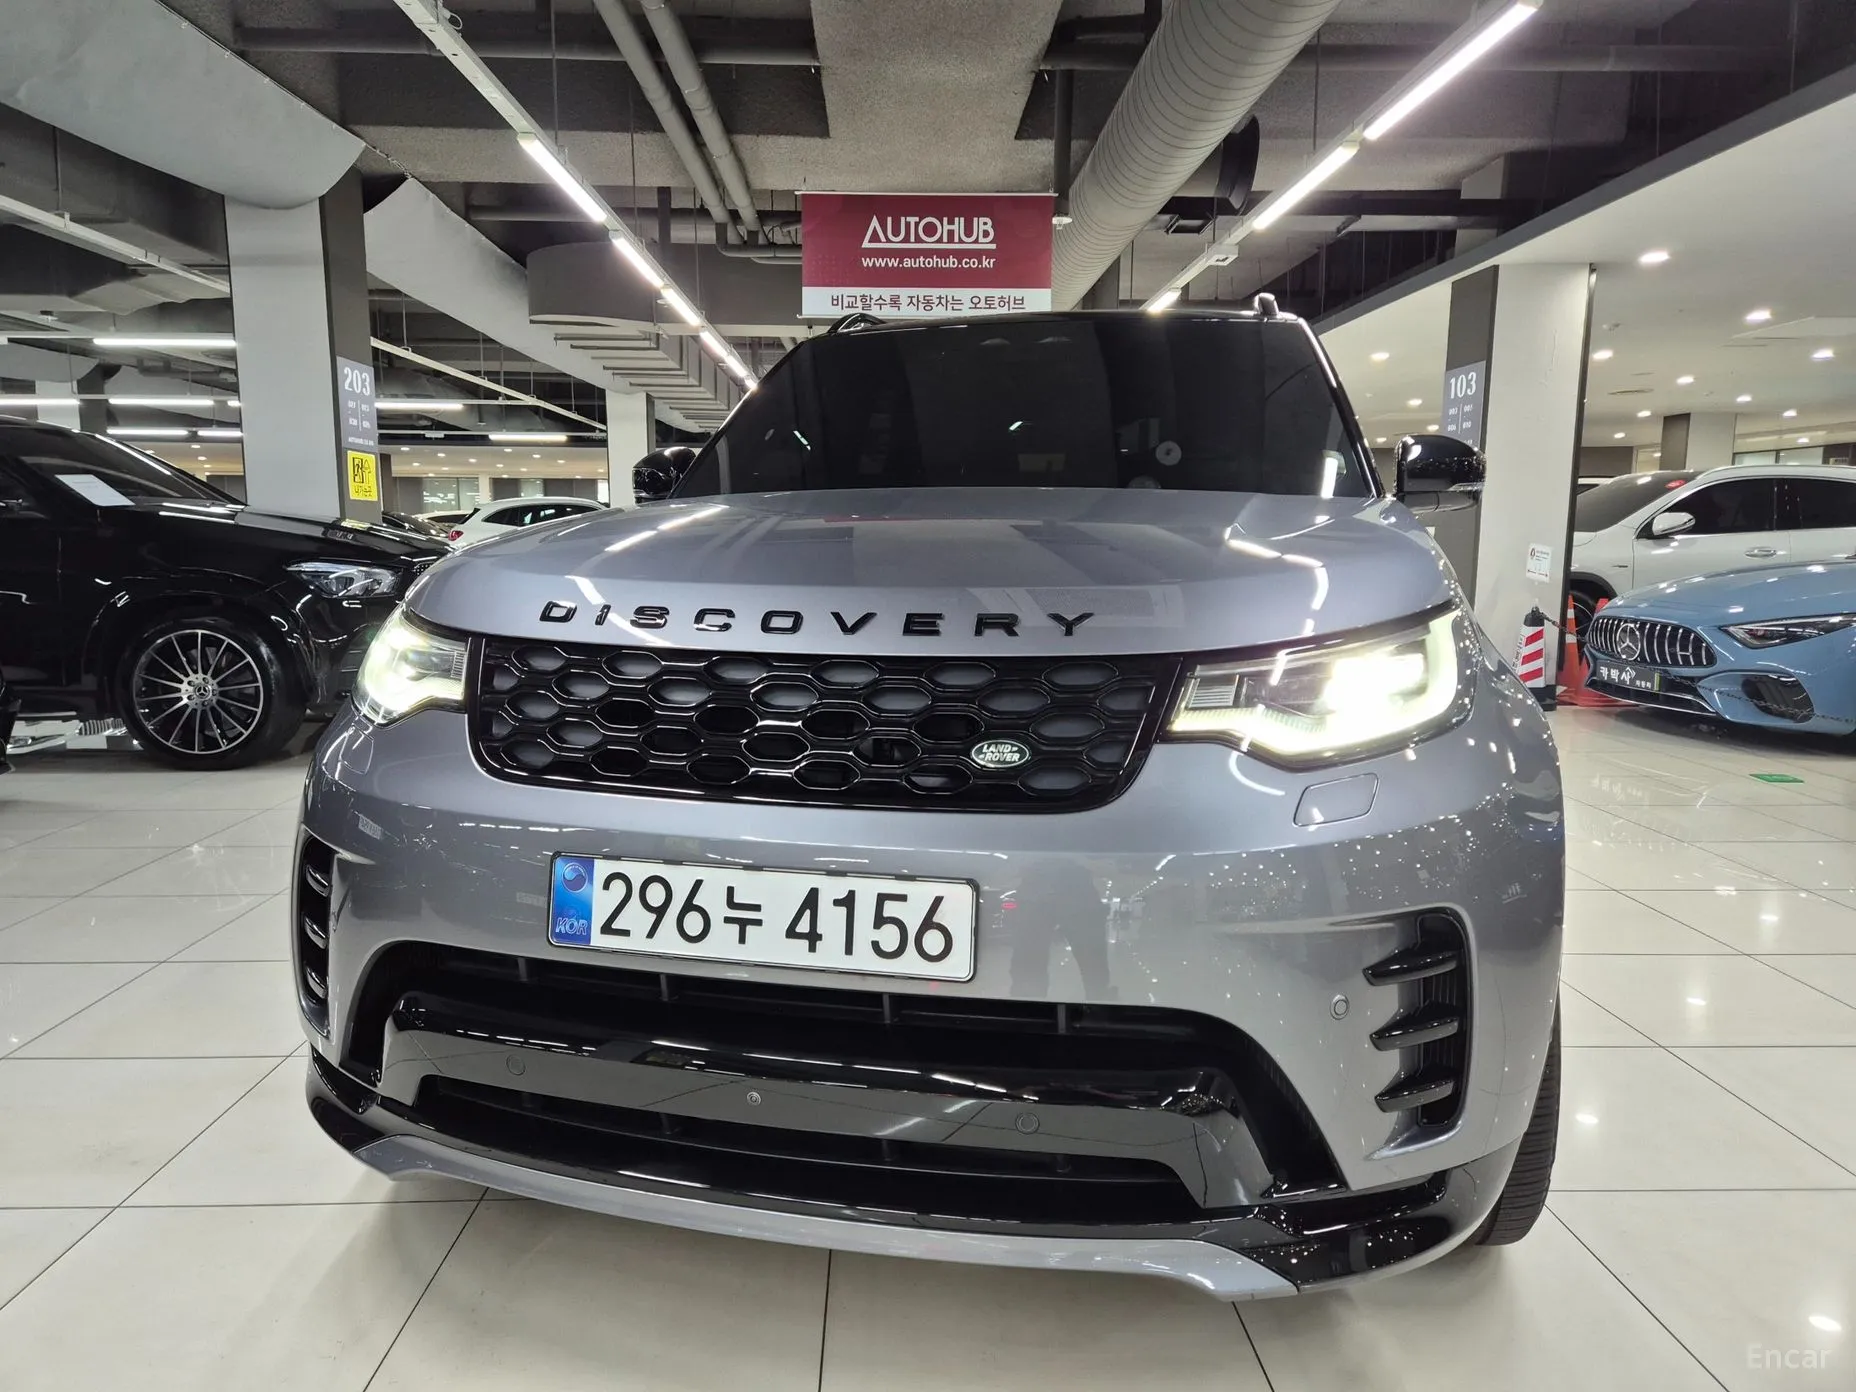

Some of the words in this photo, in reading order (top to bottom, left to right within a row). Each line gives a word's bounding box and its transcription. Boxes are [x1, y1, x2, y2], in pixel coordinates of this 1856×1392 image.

[862, 215, 996, 249] AUTOHUB
[862, 255, 996, 269] www.autohub.co.kr
[831, 294, 902, 311] 비교할수록
[906, 294, 964, 311] 자동차는
[968, 294, 1026, 311] 오토허브
[343, 366, 371, 396] 203
[1449, 371, 1477, 399] 103
[539, 599, 1095, 637] DISCOVERY
[982, 743, 1012, 753] LAND
[984, 752, 1020, 762] ROVER
[555, 917, 588, 936] KOR
[600, 871, 764, 945] 296누
[785, 887, 954, 964] 4156
